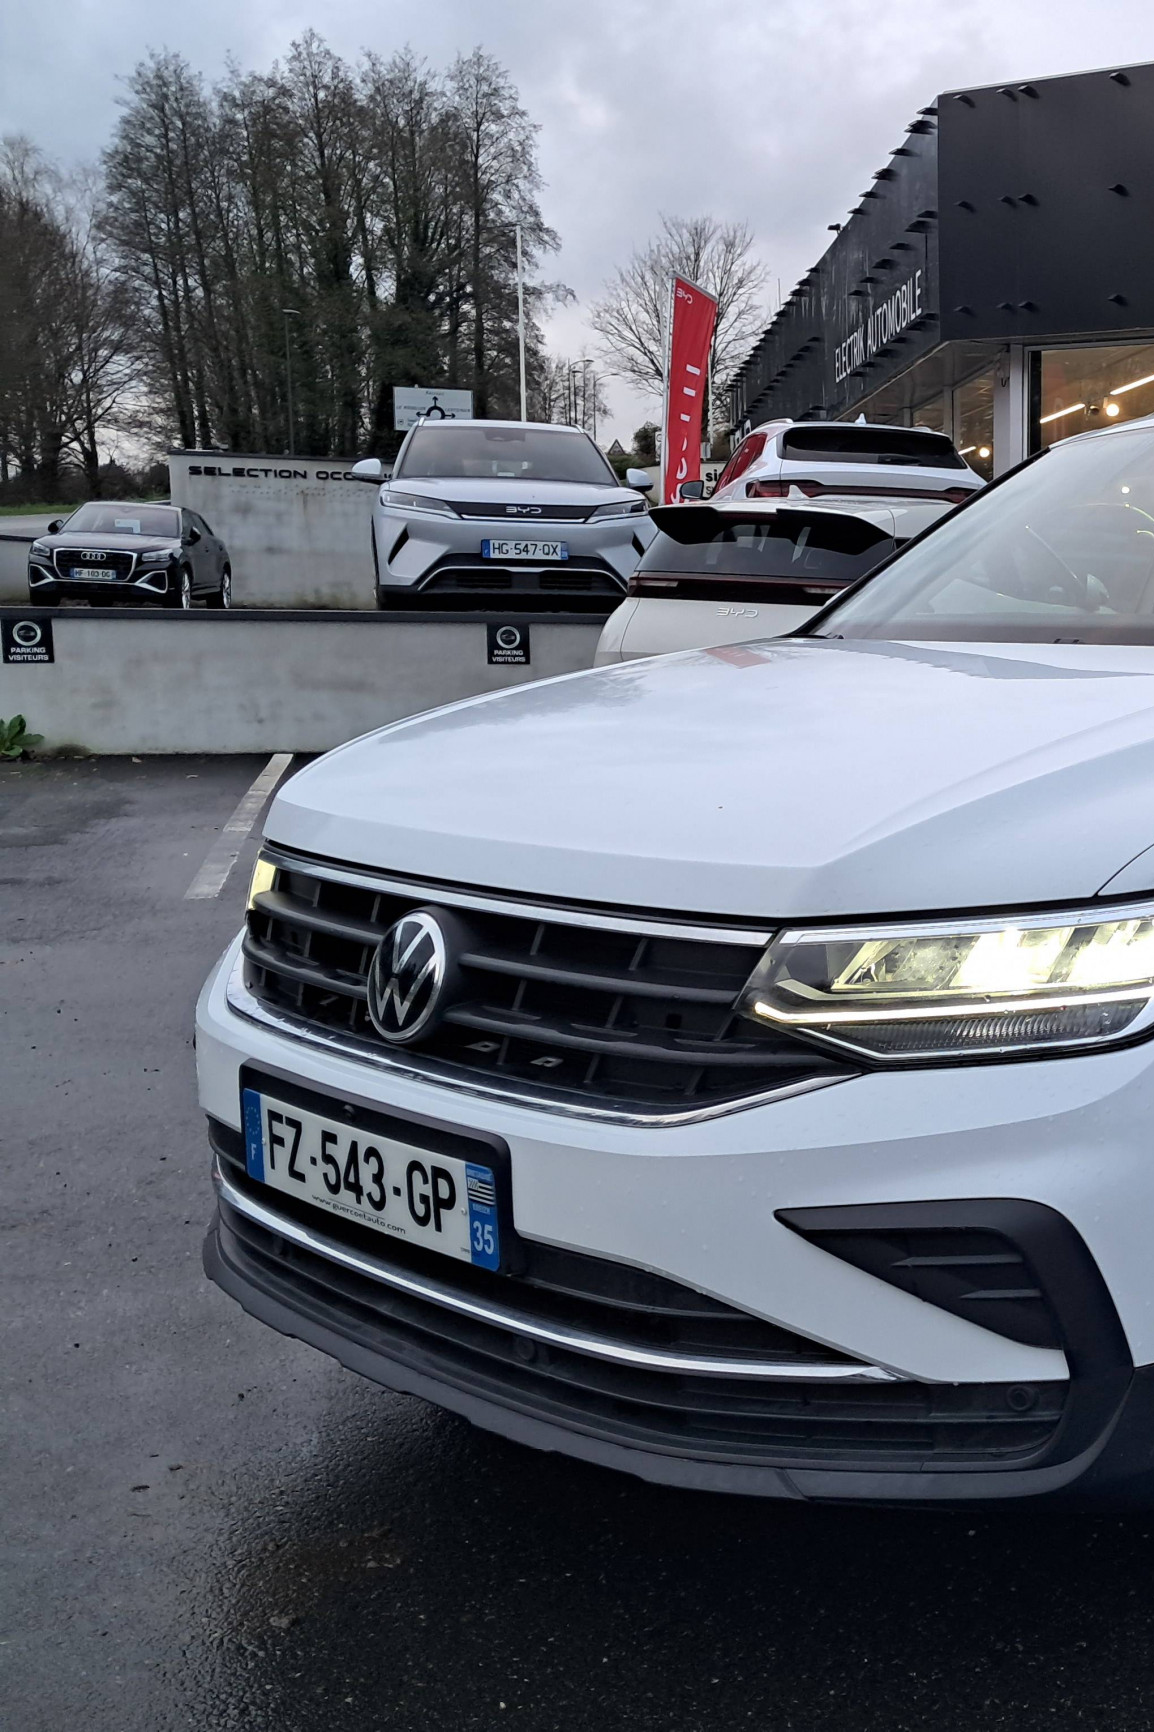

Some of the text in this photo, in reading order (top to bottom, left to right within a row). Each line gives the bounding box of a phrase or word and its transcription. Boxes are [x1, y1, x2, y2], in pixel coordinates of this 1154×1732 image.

[835, 269, 922, 383] ELECTRIK AUTOMOBILE
[188, 466, 308, 479] SELECTION
[506, 506, 541, 514] BYD
[492, 542, 559, 556] HG-547-QX
[717, 607, 758, 618] BYD
[267, 1109, 456, 1233] FZ-543-GP
[473, 1220, 494, 1255] 35
